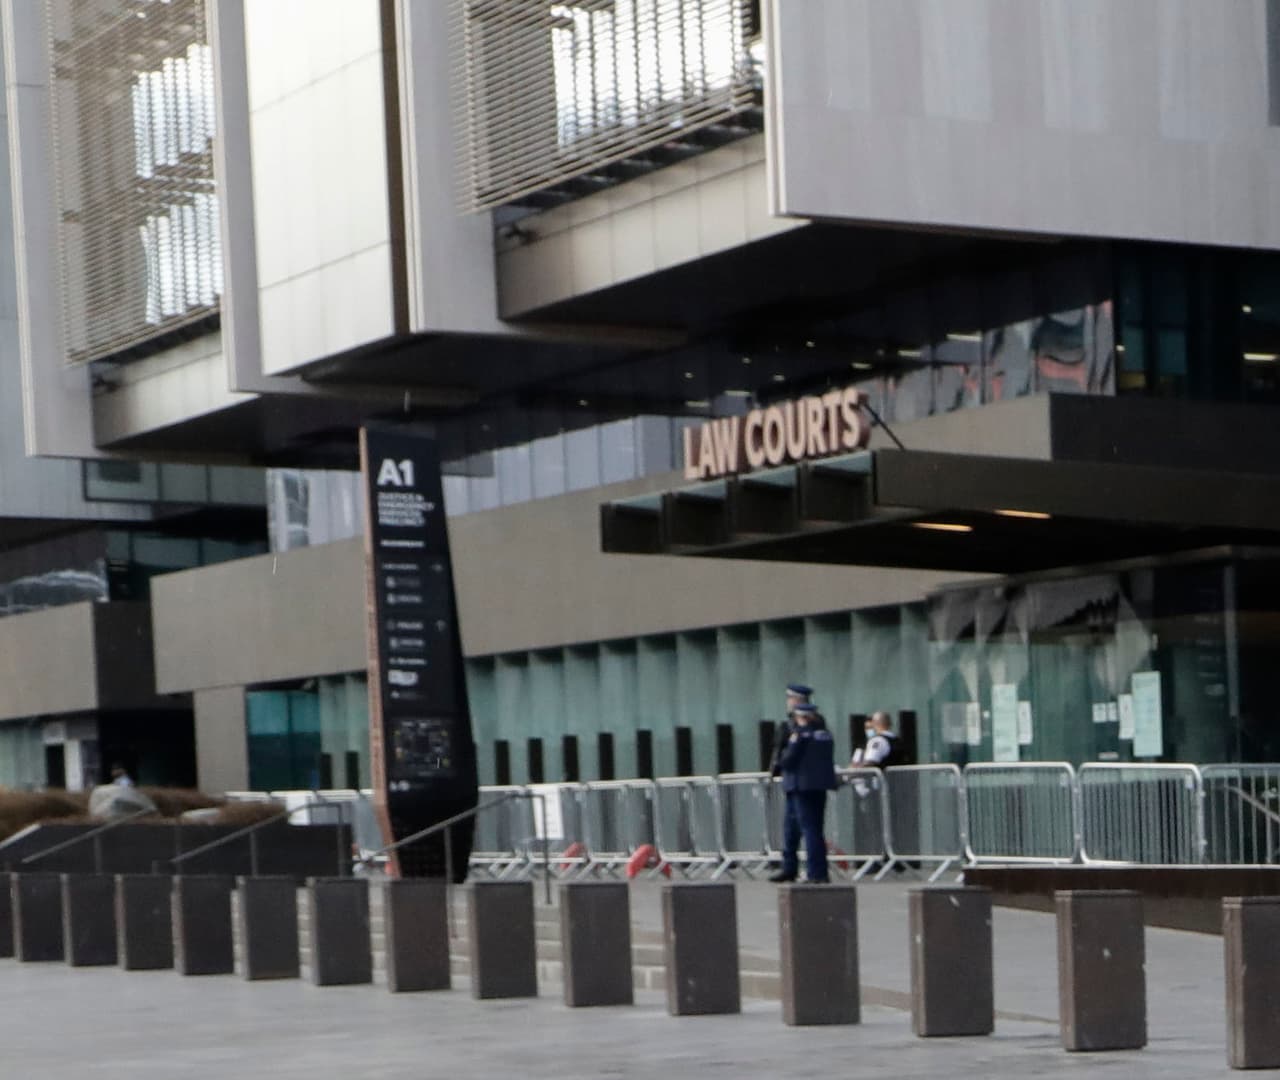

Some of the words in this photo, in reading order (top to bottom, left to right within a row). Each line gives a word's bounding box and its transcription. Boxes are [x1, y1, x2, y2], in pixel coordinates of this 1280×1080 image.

[684, 416, 739, 479] LAW
[745, 386, 860, 466] COURTS
[377, 458, 414, 486] A1
